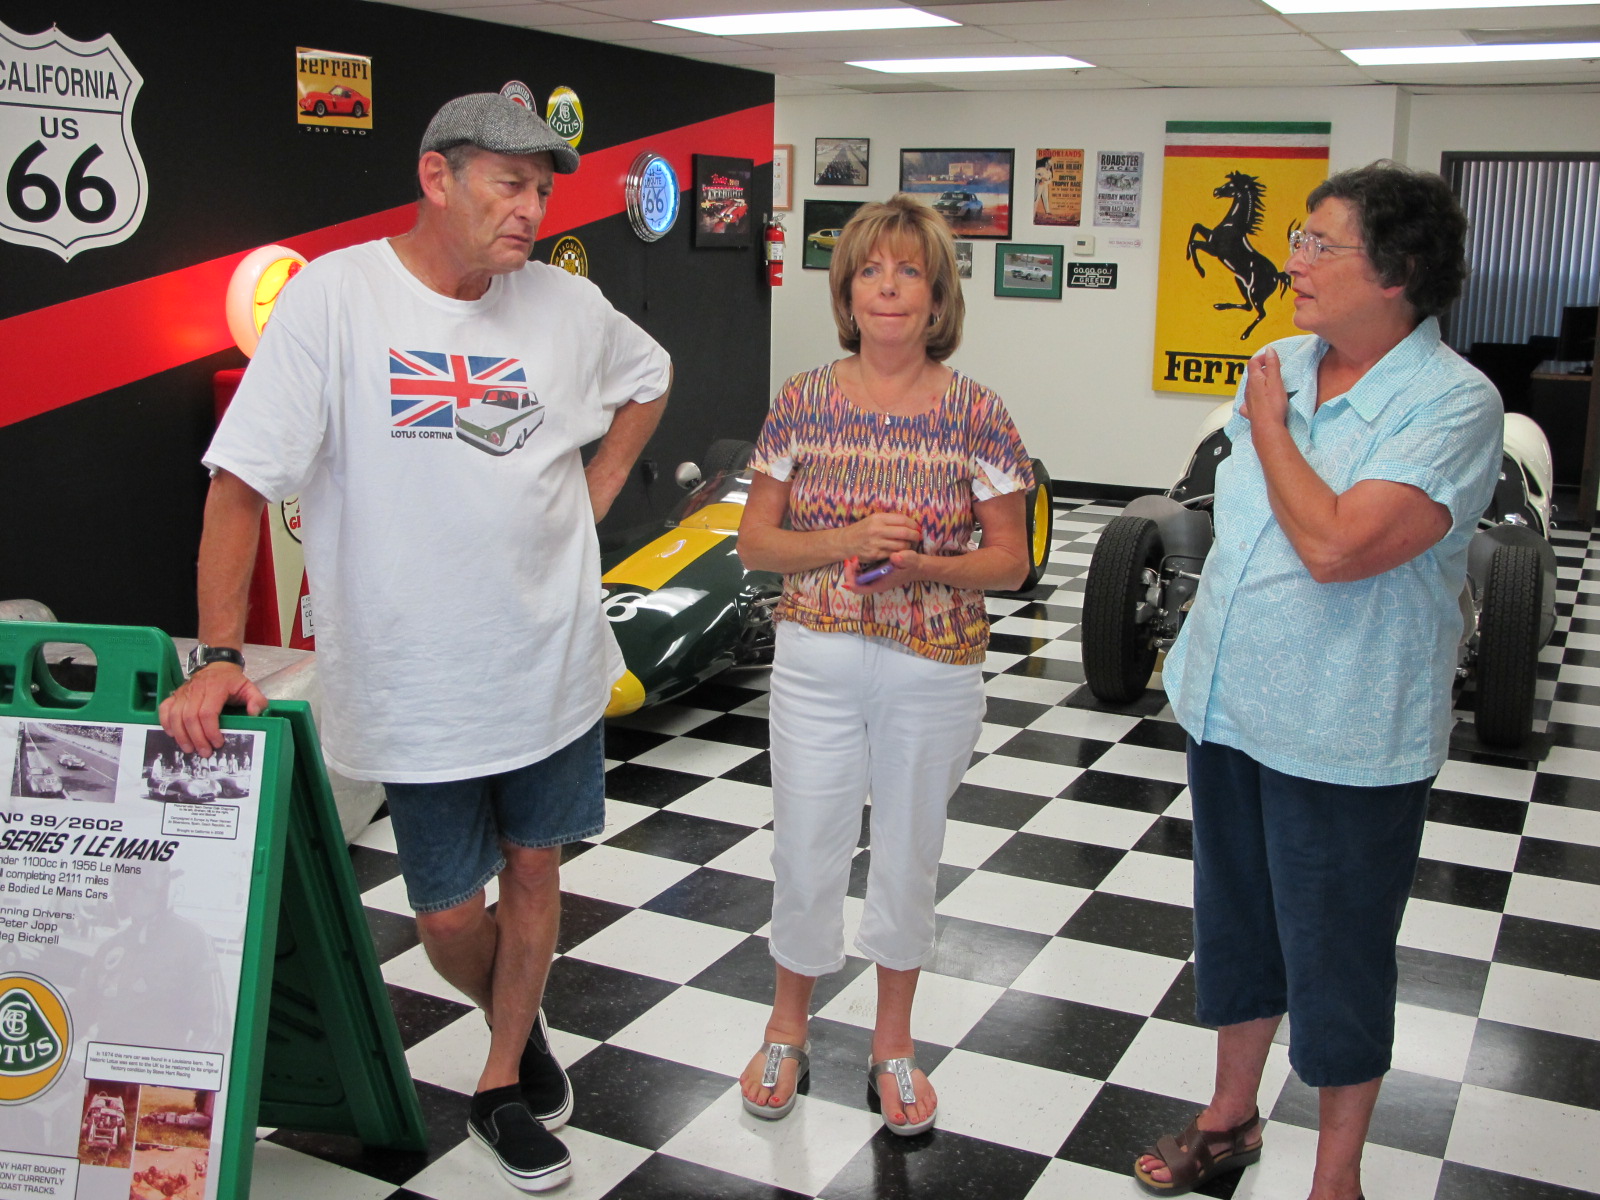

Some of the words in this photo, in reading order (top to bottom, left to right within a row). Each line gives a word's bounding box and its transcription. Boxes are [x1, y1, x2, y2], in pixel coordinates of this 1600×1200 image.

[0, 59, 119, 101] CALIFORNIA
[40, 116, 80, 139] US
[551, 117, 580, 134] LOTUS
[1101, 154, 1139, 166] ROADSTER
[6, 139, 117, 223] 66
[646, 187, 665, 213] 66
[1164, 351, 1246, 385] Ferr
[391, 430, 416, 439] LOTUS
[419, 430, 453, 439] CORTINA
[601, 589, 647, 622] 6
[30, 814, 124, 832] 99/2602
[0, 829, 70, 854] SERIES
[70, 834, 87, 855] 1
[83, 835, 116, 858] LE
[110, 837, 180, 862] MANS
[0, 856, 19, 865] nder
[23, 856, 58, 868] 1100cc
[60, 859, 68, 869] in
[72, 860, 97, 871] 1956
[100, 862, 111, 872] Le
[114, 863, 142, 875] Mans
[6, 870, 56, 884] completing
[59, 873, 81, 884] 2111
[85, 875, 109, 886] miles
[8, 883, 40, 894] Bodied
[43, 885, 53, 895] Le
[56, 886, 83, 898] Mans
[86, 889, 108, 900] Cars
[0, 907, 29, 918] nning
[33, 908, 75, 920] Drivers:
[0, 917, 28, 928] Peter
[31, 920, 58, 933] Jopp
[0, 931, 14, 943] eg
[18, 932, 60, 944] Bicknell
[0, 1036, 54, 1064] TUS
[0, 1162, 9, 1170] NY
[11, 1163, 32, 1172] HART
[34, 1165, 66, 1175] BOUGHT
[0, 1172, 17, 1180] ONY
[18, 1173, 65, 1186] CURRENTLY
